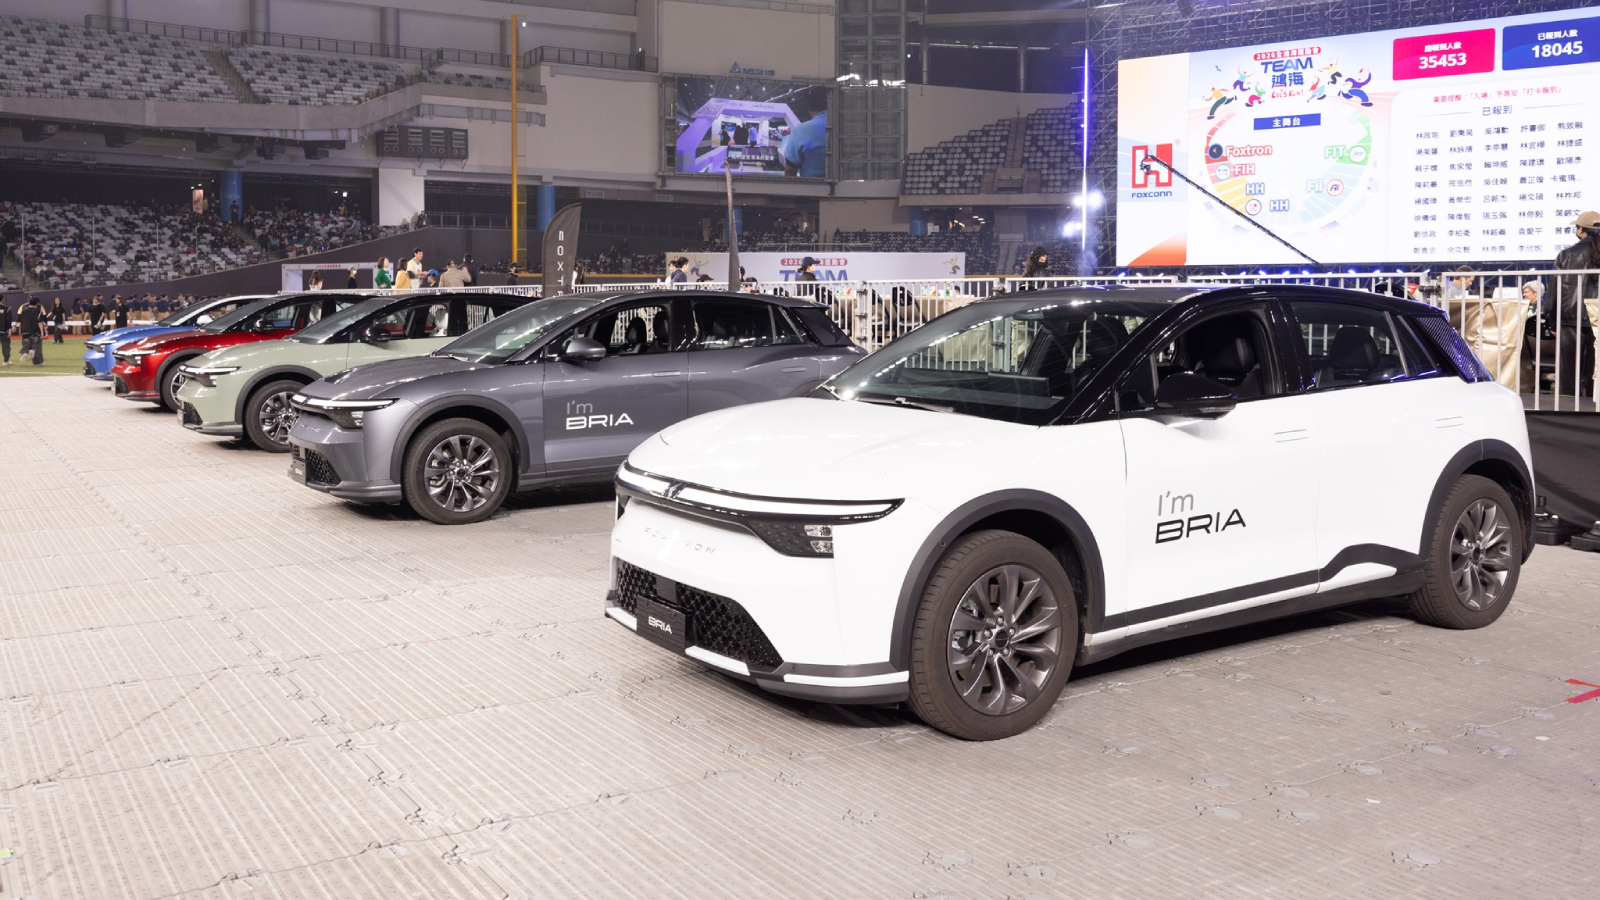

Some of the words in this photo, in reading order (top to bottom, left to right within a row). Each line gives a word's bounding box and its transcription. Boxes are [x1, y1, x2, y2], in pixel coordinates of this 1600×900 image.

[1532, 40, 1582, 58] 18045
[1261, 57, 1313, 73] TEAM
[1418, 53, 1467, 69] 35453
[1272, 72, 1304, 88] 鴻海
[1482, 104, 1513, 117] 已報到
[1272, 117, 1301, 128] 主舞台
[1225, 144, 1272, 158] Foxtron
[1324, 145, 1346, 160] FIT
[1234, 163, 1256, 177] FIH
[1131, 191, 1173, 199] FOXCONN
[1245, 182, 1265, 196] HH
[1269, 198, 1290, 212] HH
[566, 400, 593, 414] I'm
[566, 413, 634, 430] BRIA
[1158, 490, 1194, 516] I'm
[1155, 508, 1246, 544] BRIA
[648, 615, 673, 635] BRIA
